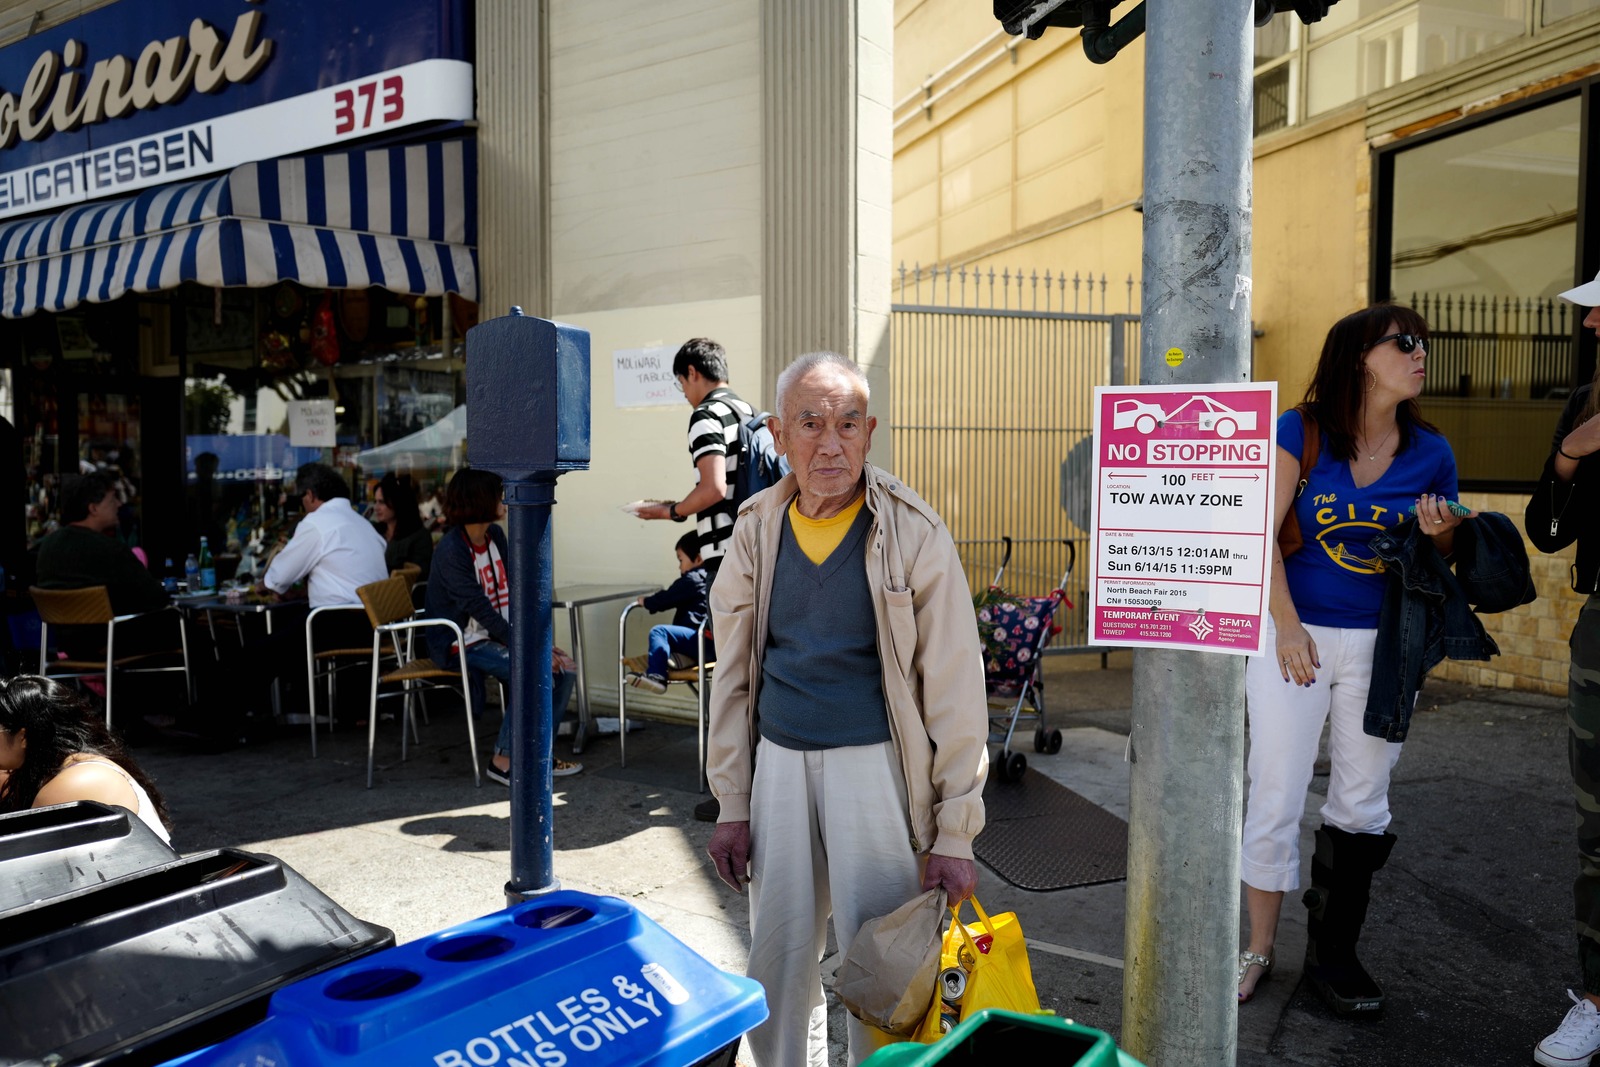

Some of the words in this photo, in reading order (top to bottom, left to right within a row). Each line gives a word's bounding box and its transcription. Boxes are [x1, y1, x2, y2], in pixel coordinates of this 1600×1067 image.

[335, 75, 404, 135] 373
[1108, 444, 1140, 460] NO
[1152, 444, 1261, 461] STOPPING
[1162, 474, 1186, 486] 100
[1110, 492, 1145, 504] TOW
[1150, 494, 1195, 506] AWAY
[1200, 494, 1242, 506] ZONE
[1313, 493, 1337, 506] The
[1108, 544, 1128, 554] Sat
[1131, 546, 1173, 556] 6/13/15
[1178, 547, 1229, 559] 12:01AM
[1108, 561, 1131, 571] Sun
[1135, 562, 1177, 573] 6/14/15
[1181, 564, 1232, 576] 11:59PM
[1103, 611, 1152, 620] TEMPORARY
[1154, 613, 1180, 621] EVENT
[1219, 618, 1252, 628] SFMTA
[433, 988, 610, 1067] BOTTLES
[612, 976, 644, 999] &
[570, 991, 662, 1052] ONLY
